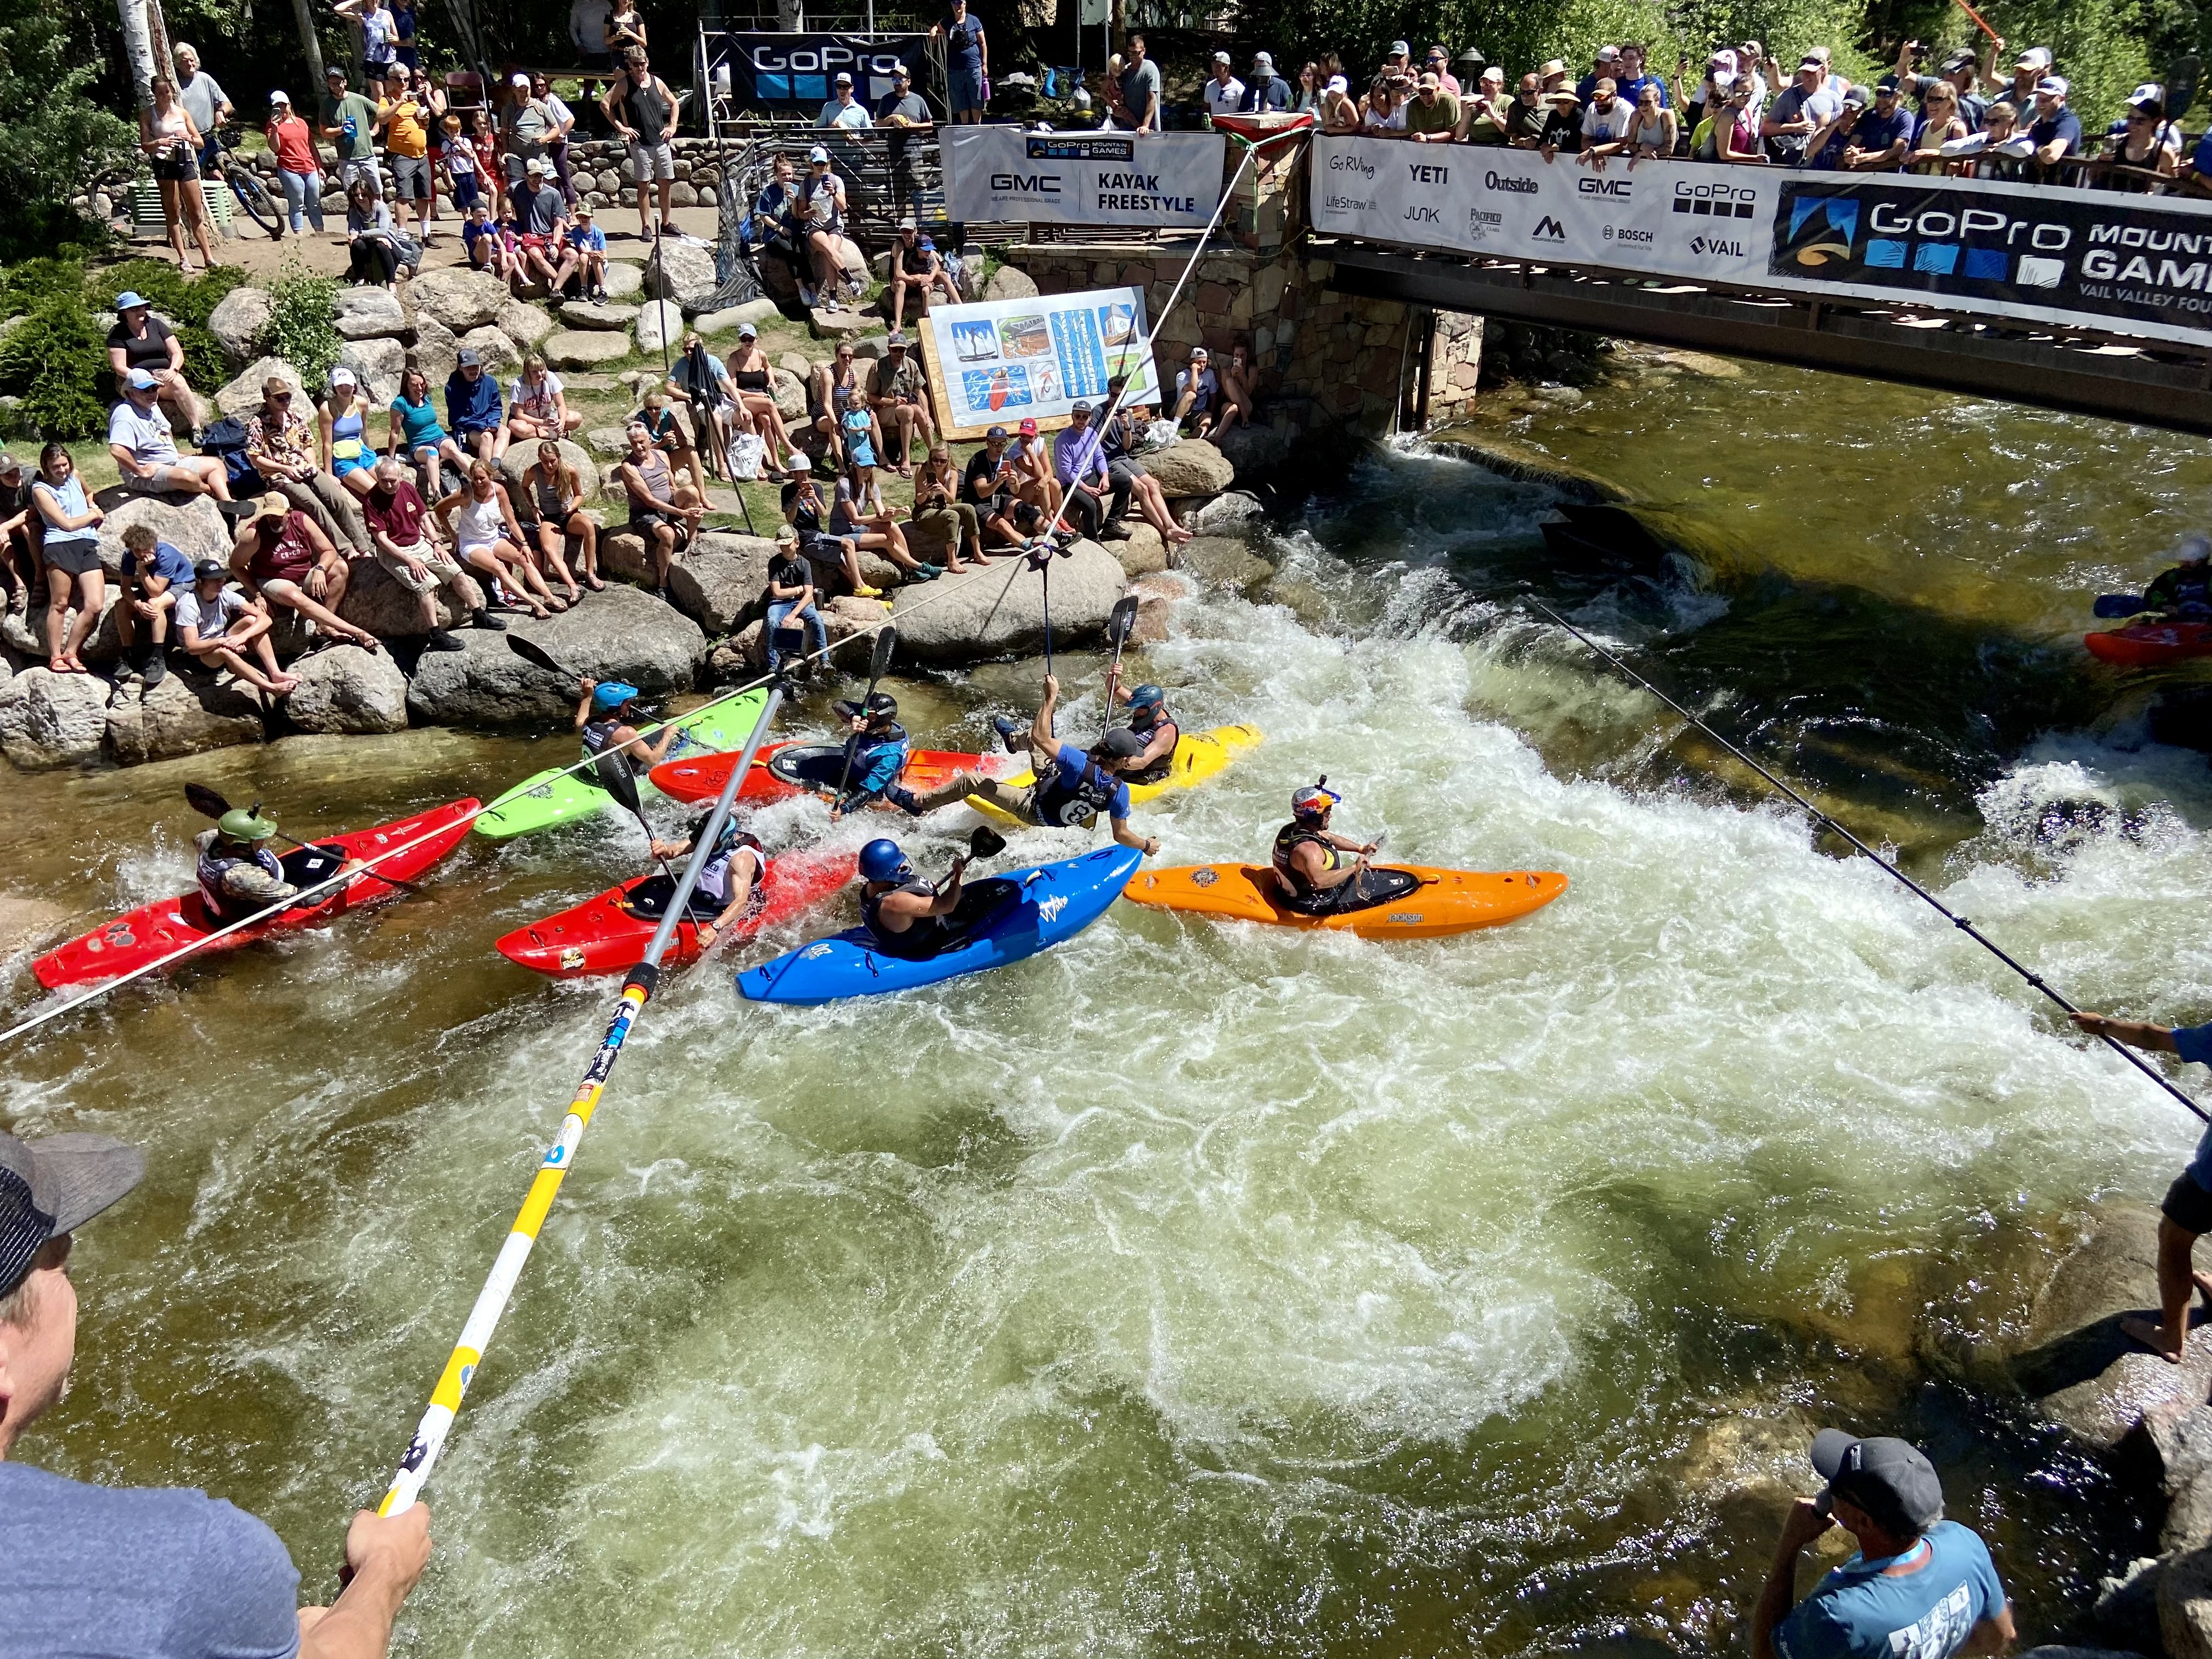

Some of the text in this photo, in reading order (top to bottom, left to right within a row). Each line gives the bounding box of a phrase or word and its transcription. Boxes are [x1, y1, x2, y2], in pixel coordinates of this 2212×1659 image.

[754, 47, 900, 74] GoPro
[1329, 155, 1374, 179] Go RVing
[1409, 164, 1448, 184] YETI
[991, 173, 1061, 193] GMC
[1098, 172, 1159, 191] KAYAK
[1485, 171, 1538, 194] Outside
[1578, 178, 1633, 196] GMC
[1675, 181, 1756, 201] GoPro
[1098, 193, 1195, 212] FREESTYLE
[1326, 195, 1367, 210] LifeStraw
[1403, 206, 1440, 223] JUNK
[1618, 229, 1653, 242] BOSCH
[1870, 202, 2071, 251] GoPro
[1708, 239, 1744, 257] VAIL
[2080, 283, 2112, 299] VAIL
[2115, 288, 2175, 307] VALLEY
[1125, 611, 1133, 631] WERNER
[611, 753, 628, 778] WERNER
